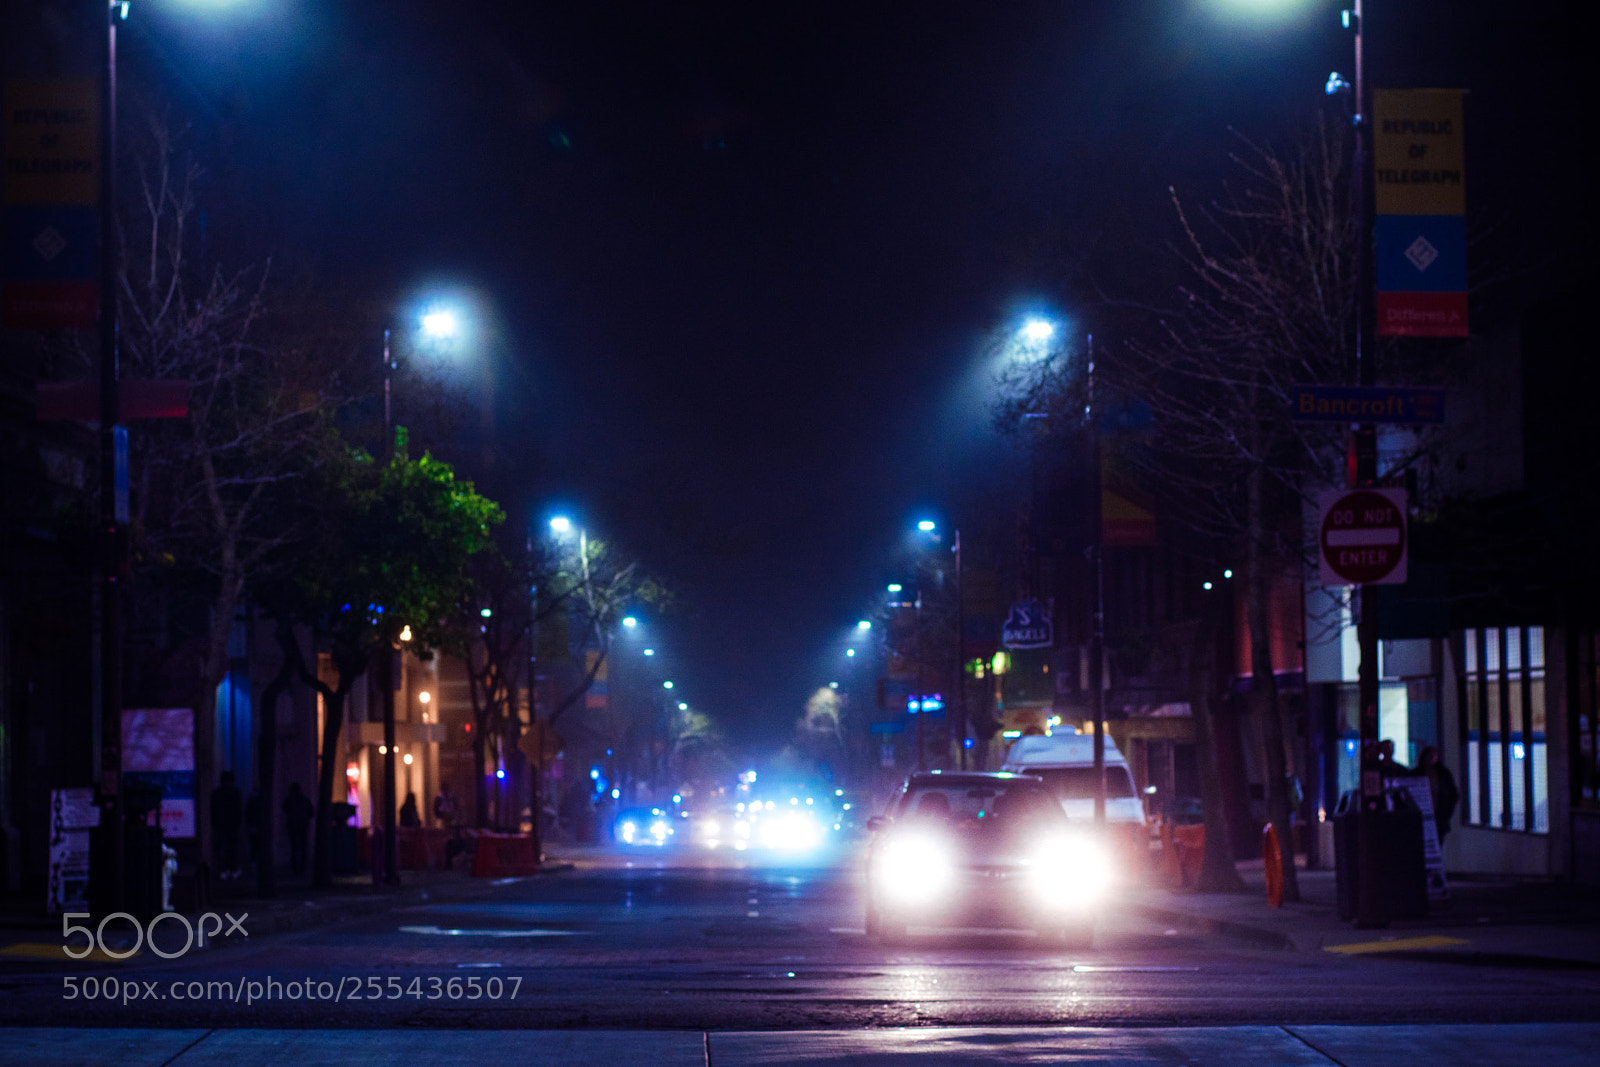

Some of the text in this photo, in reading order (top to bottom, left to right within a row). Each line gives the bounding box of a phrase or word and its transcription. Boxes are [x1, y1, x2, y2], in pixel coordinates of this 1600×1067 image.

[1382, 120, 1453, 134] REPUBLIC
[1408, 145, 1428, 159] OF
[1377, 169, 1460, 184] TELEGRAPH
[1299, 393, 1404, 416] Bancroft
[1333, 508, 1393, 525] DO NOT
[1339, 550, 1388, 566] ENTER
